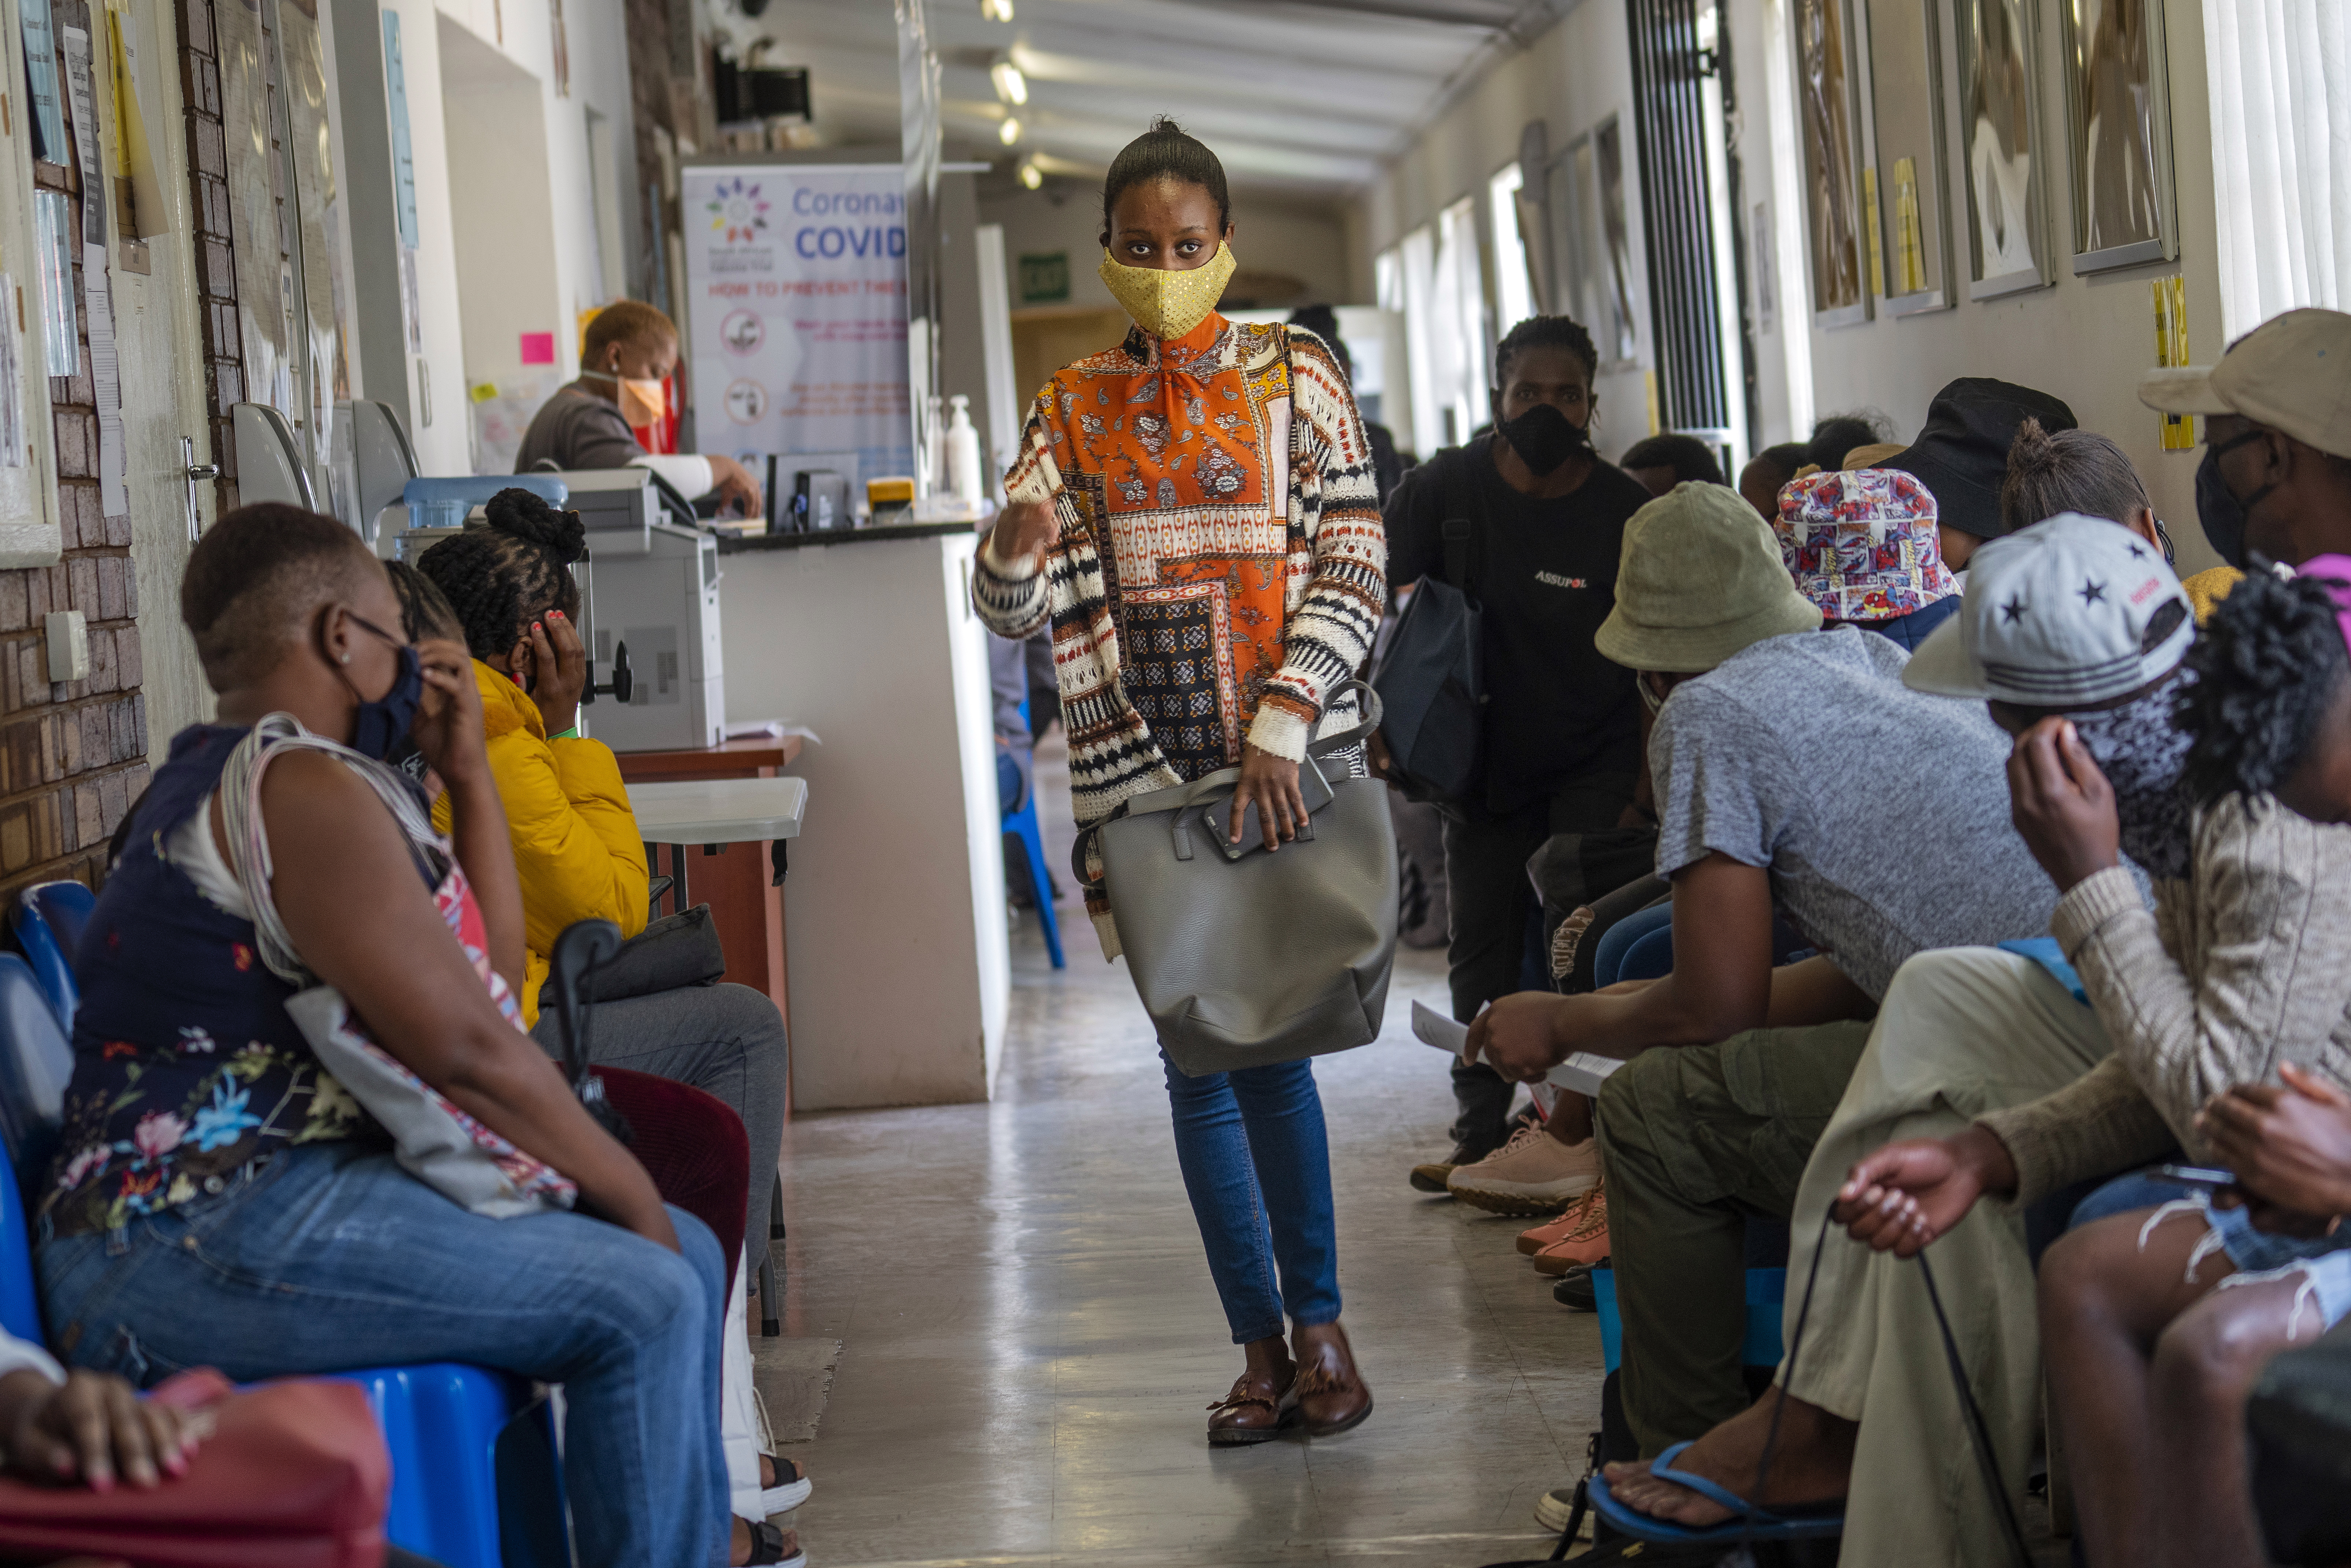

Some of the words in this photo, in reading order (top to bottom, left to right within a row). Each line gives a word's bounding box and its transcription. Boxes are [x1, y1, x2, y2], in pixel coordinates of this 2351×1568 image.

[796, 227, 906, 259] COVID
[755, 282, 779, 297] TO
[1535, 570, 1587, 588] ASSUPOL
